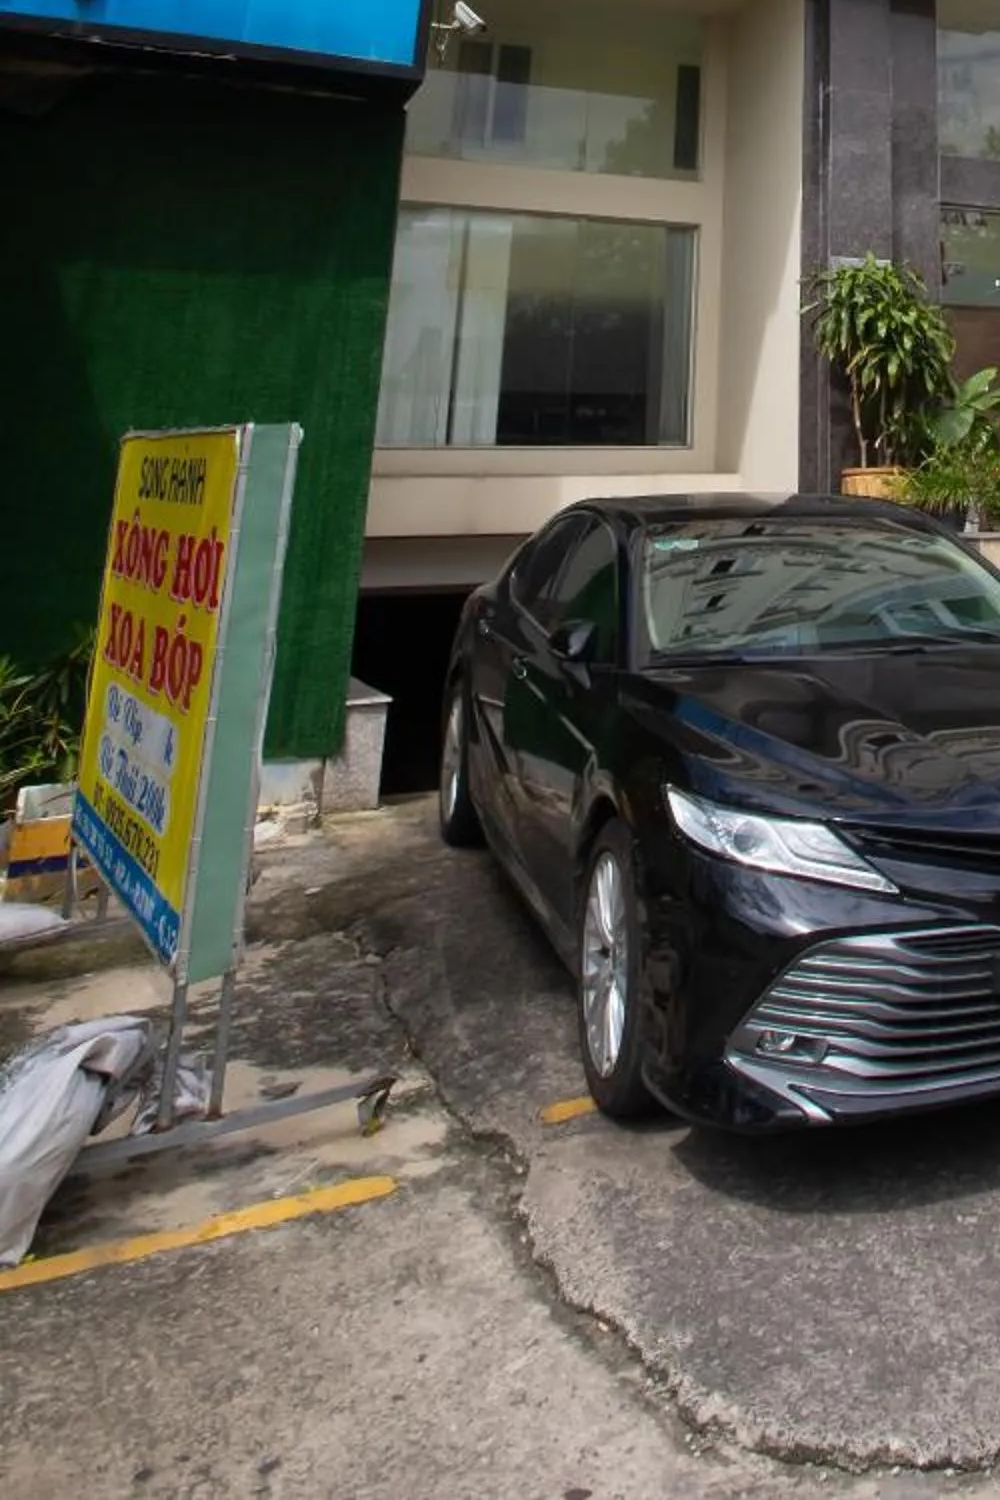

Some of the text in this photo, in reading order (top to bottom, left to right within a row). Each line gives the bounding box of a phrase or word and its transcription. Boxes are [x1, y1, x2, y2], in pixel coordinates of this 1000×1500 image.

[138, 455, 170, 501] SONG
[111, 506, 225, 612] XÔNG HƠI
[103, 602, 204, 714] XOA BÓP
